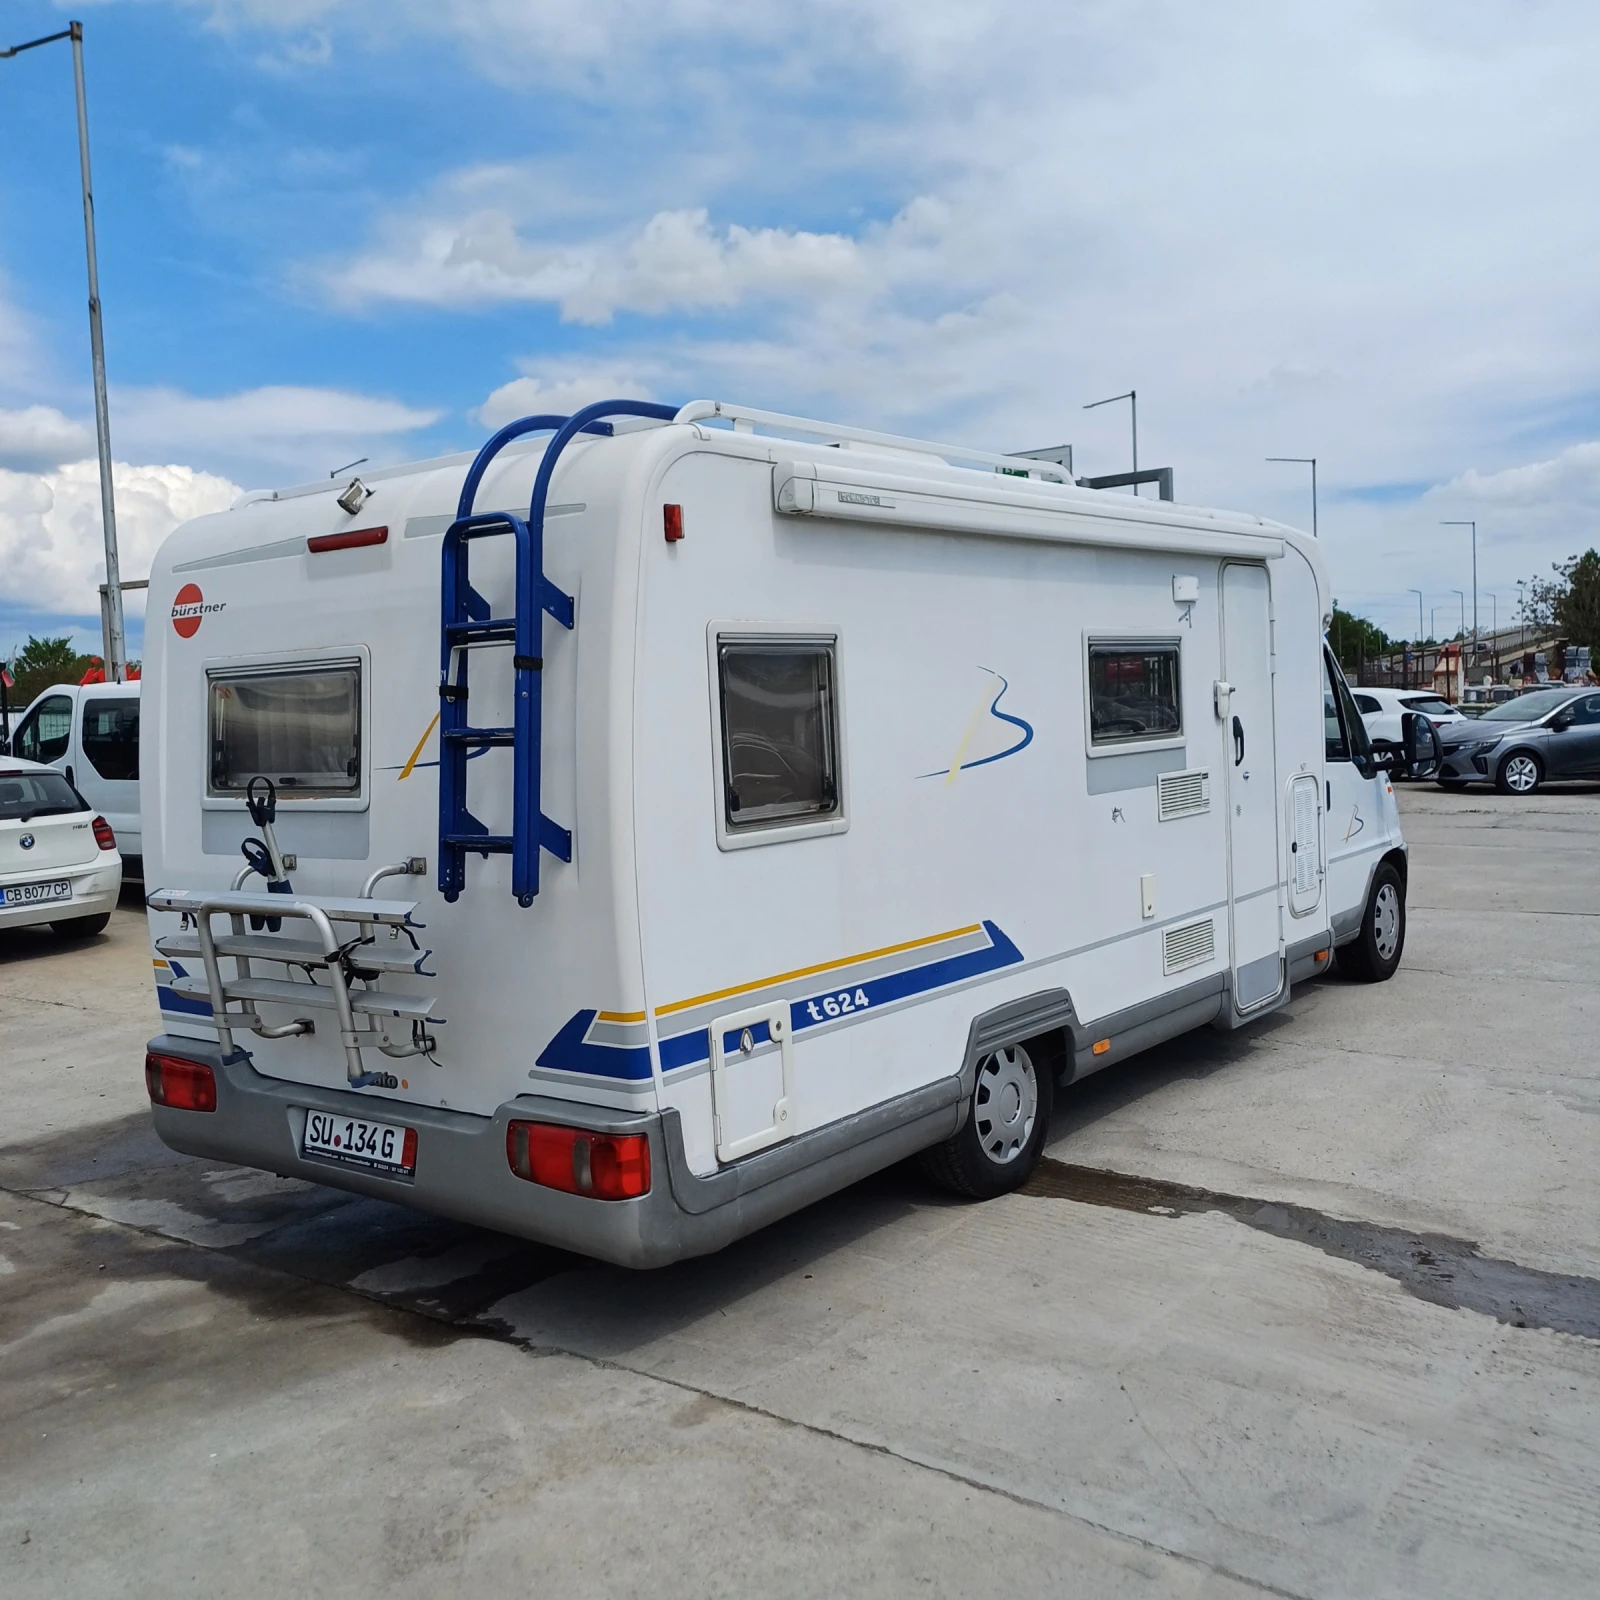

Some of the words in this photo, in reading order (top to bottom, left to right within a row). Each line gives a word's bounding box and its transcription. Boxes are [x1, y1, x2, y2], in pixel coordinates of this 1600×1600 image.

[171, 602, 227, 617] bürstner
[6, 888, 22, 902] CB
[24, 884, 51, 899] 8077
[54, 882, 68, 895] CP
[310, 1115, 334, 1146] SU
